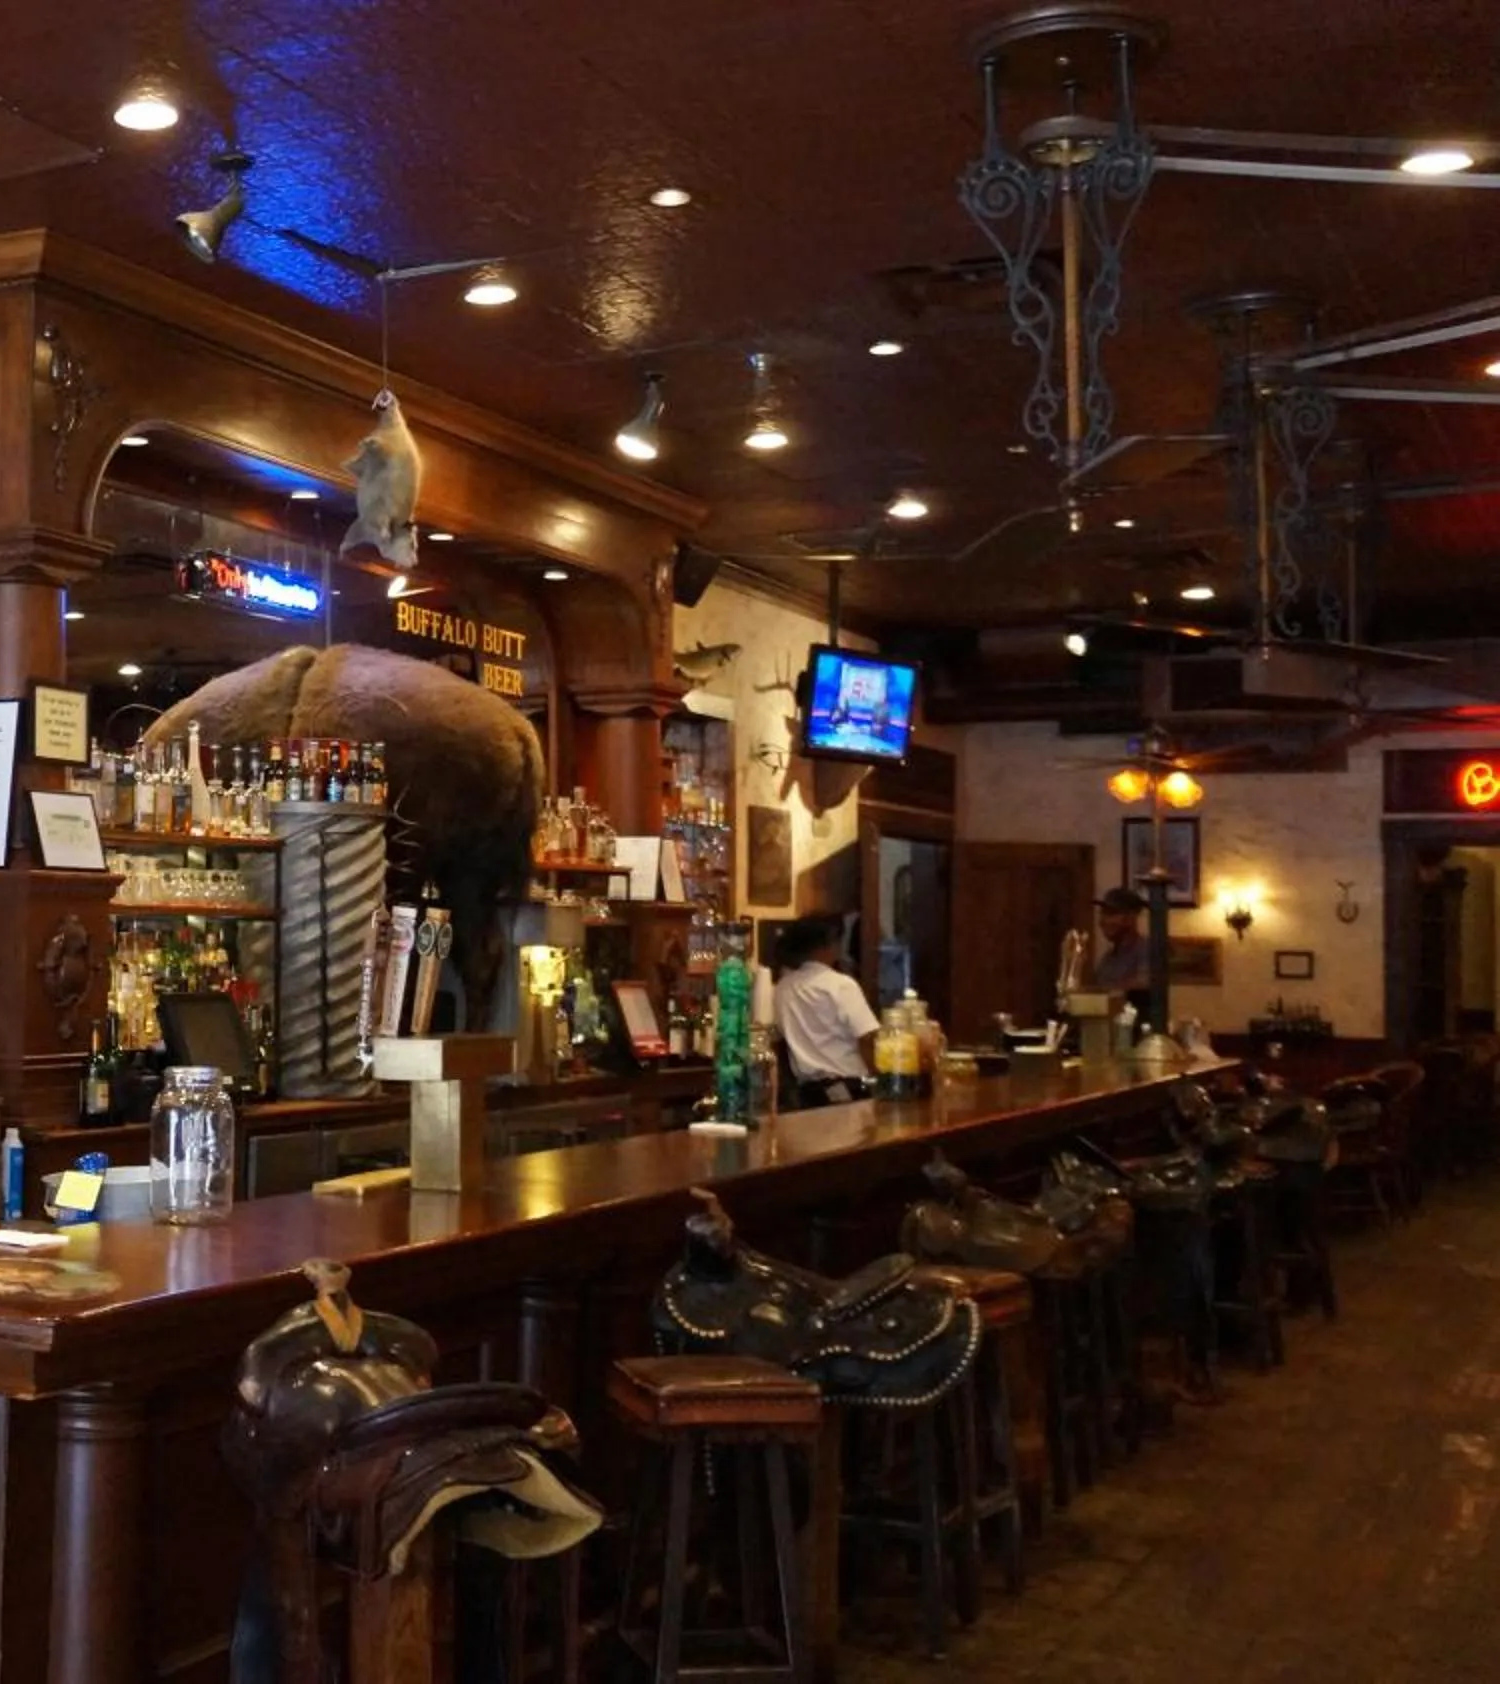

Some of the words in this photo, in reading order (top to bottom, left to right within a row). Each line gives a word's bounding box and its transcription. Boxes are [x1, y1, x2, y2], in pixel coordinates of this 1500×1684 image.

[397, 601, 477, 649] BUFFALO
[483, 623, 526, 660] BUTT
[484, 663, 524, 697] BEER
